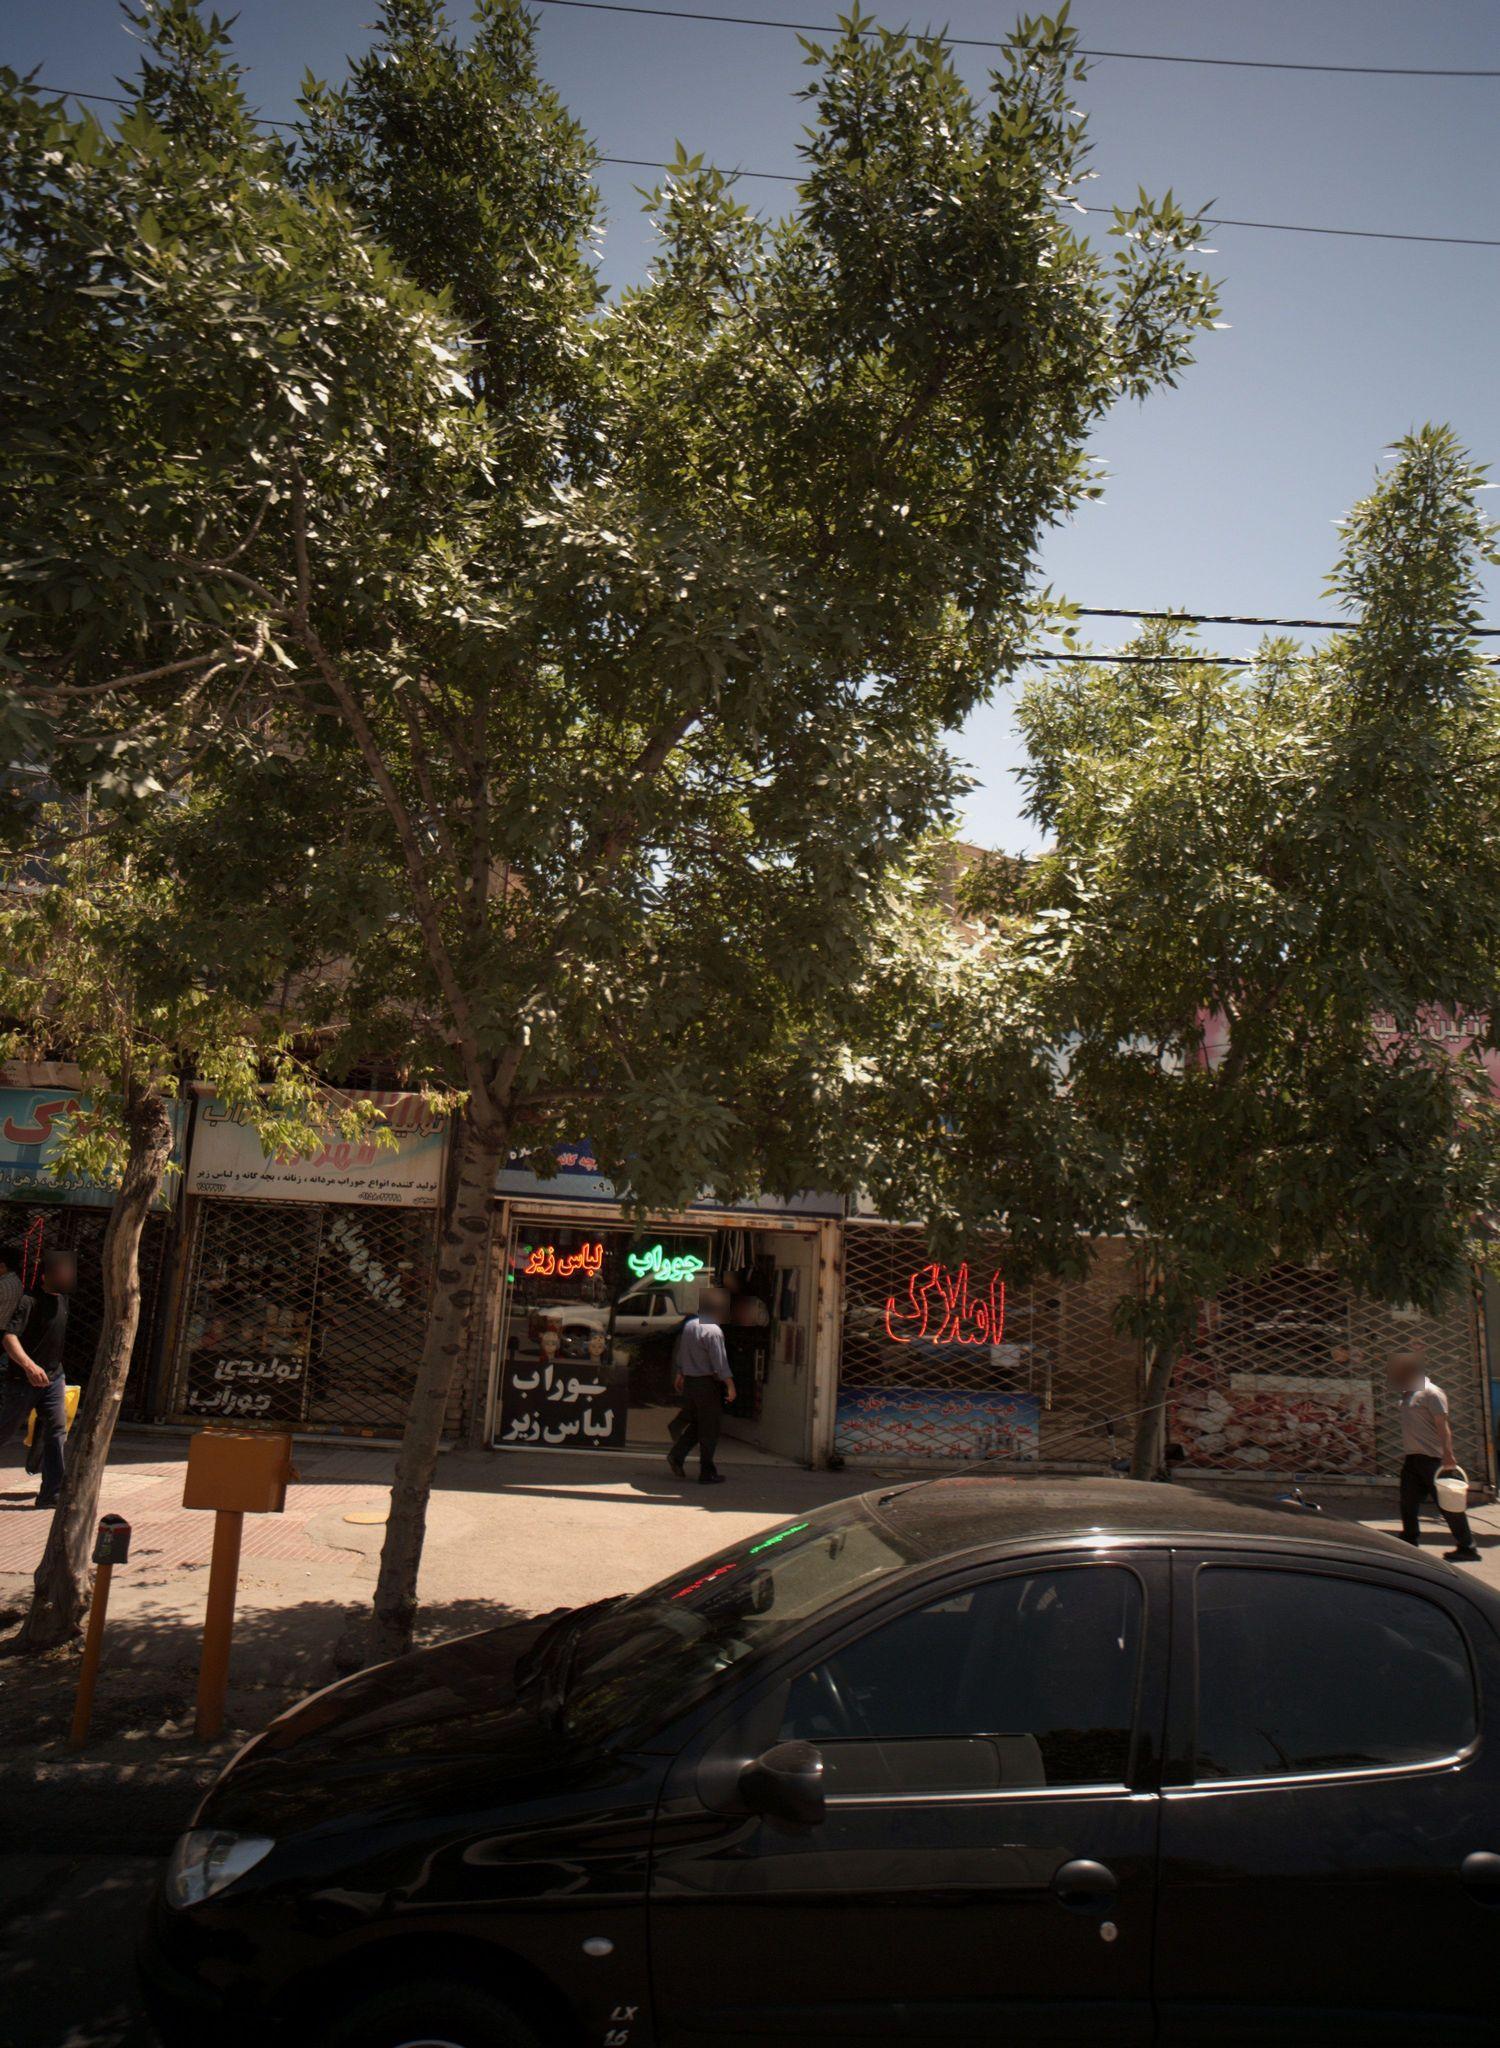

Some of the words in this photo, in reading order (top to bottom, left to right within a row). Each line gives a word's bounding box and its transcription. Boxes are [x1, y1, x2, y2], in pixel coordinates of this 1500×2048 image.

[196, 1169, 210, 1179] زیر
[211, 1170, 233, 1180] لباس
[241, 1171, 258, 1179] گانه
[260, 1173, 275, 1182] بچه
[283, 1173, 302, 1184] زنانه
[309, 1175, 335, 1185] مردانه
[338, 1177, 366, 1188] جوراب
[368, 1178, 390, 1189] انواع
[391, 1180, 414, 1188] کننده
[415, 1182, 438, 1192] تولید
[524, 1246, 556, 1275] زیر
[558, 1242, 603, 1277] لباس
[214, 1357, 303, 1383] تولیدی
[189, 1385, 272, 1416] جوراب
[502, 1411, 541, 1441] زیر
[543, 1408, 615, 1446] لباس
[608, 2006, 639, 2021] LX
